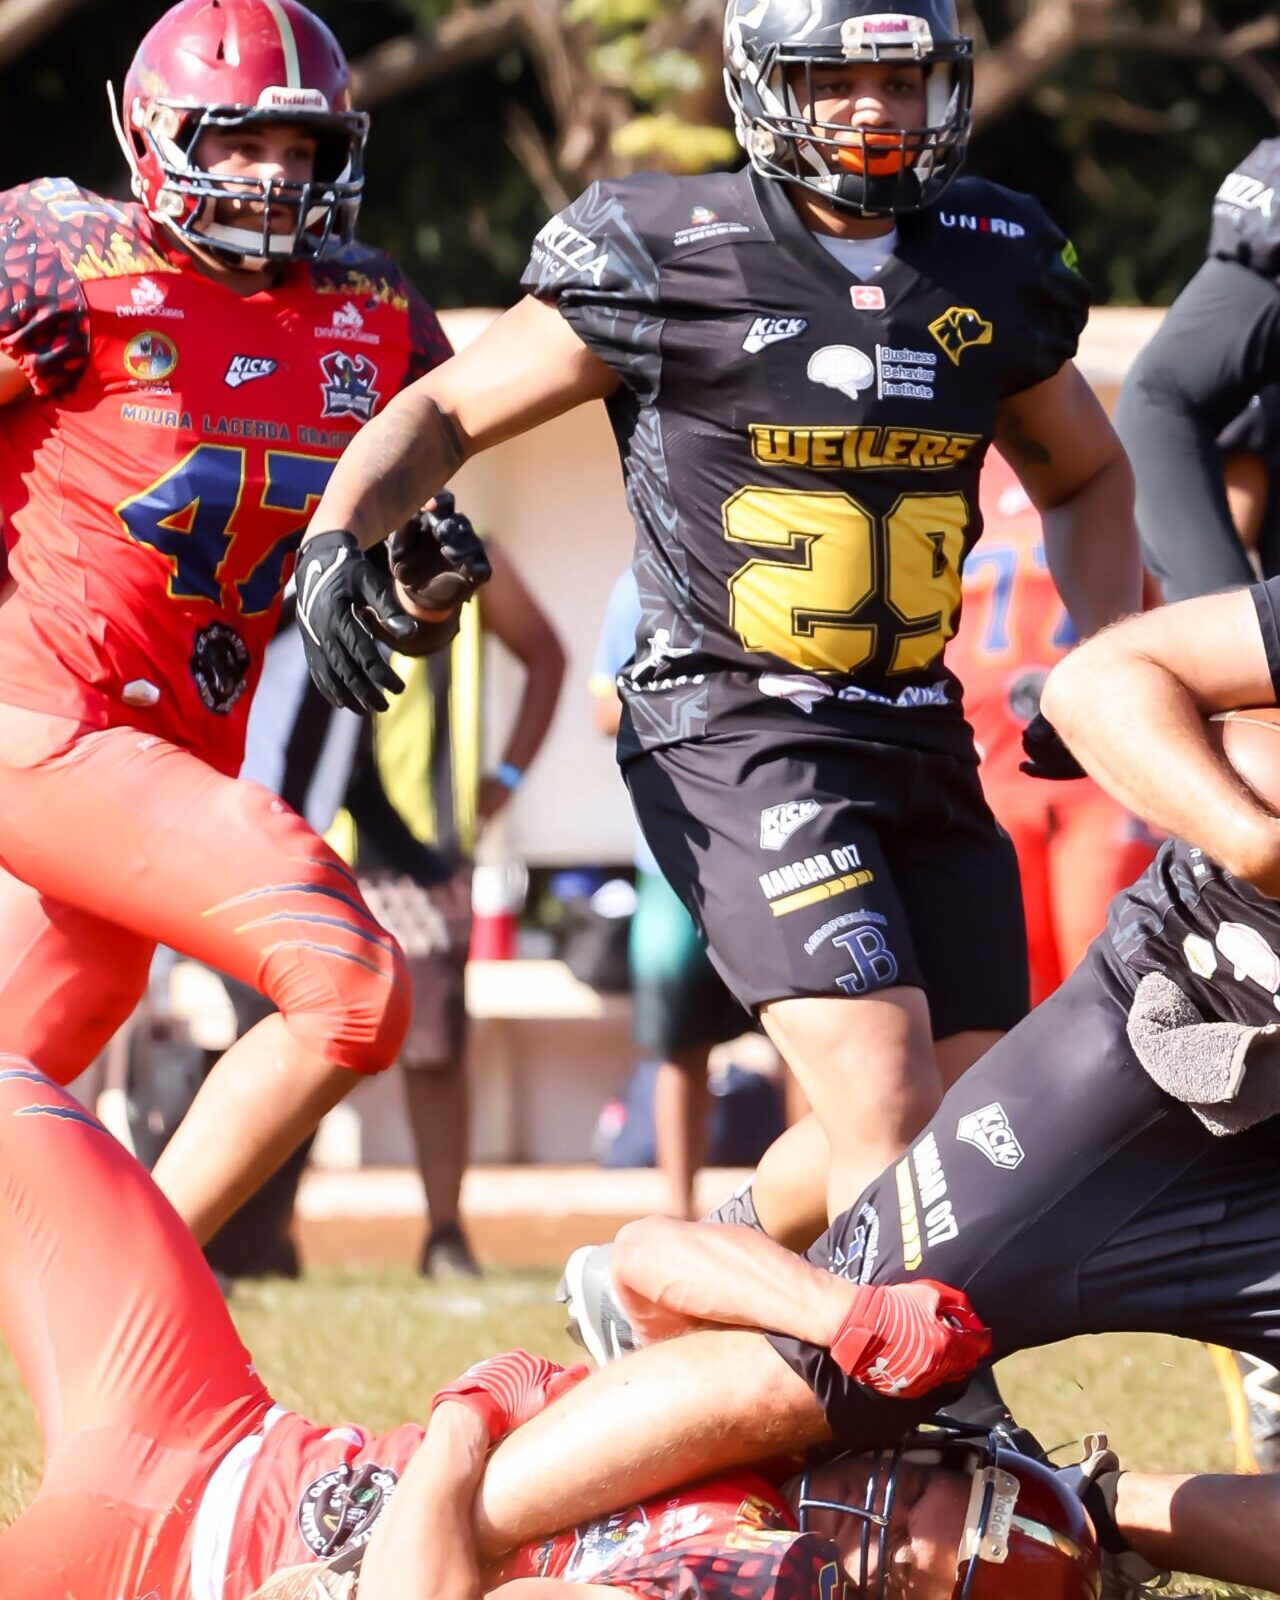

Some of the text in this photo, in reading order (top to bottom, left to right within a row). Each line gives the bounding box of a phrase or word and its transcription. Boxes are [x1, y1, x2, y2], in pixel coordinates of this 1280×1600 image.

[939, 211, 1026, 239] UNIRP
[882, 346, 937, 364] Business
[882, 364, 935, 382] Behavior
[882, 381, 934, 399] Institute
[121, 402, 192, 429] MOURA
[203, 415, 290, 441] LACERDA
[748, 423, 983, 470] WEILERS
[113, 443, 341, 617] 47
[721, 485, 970, 676] 29
[831, 844, 863, 873] 017
[924, 1200, 960, 1248] 017
